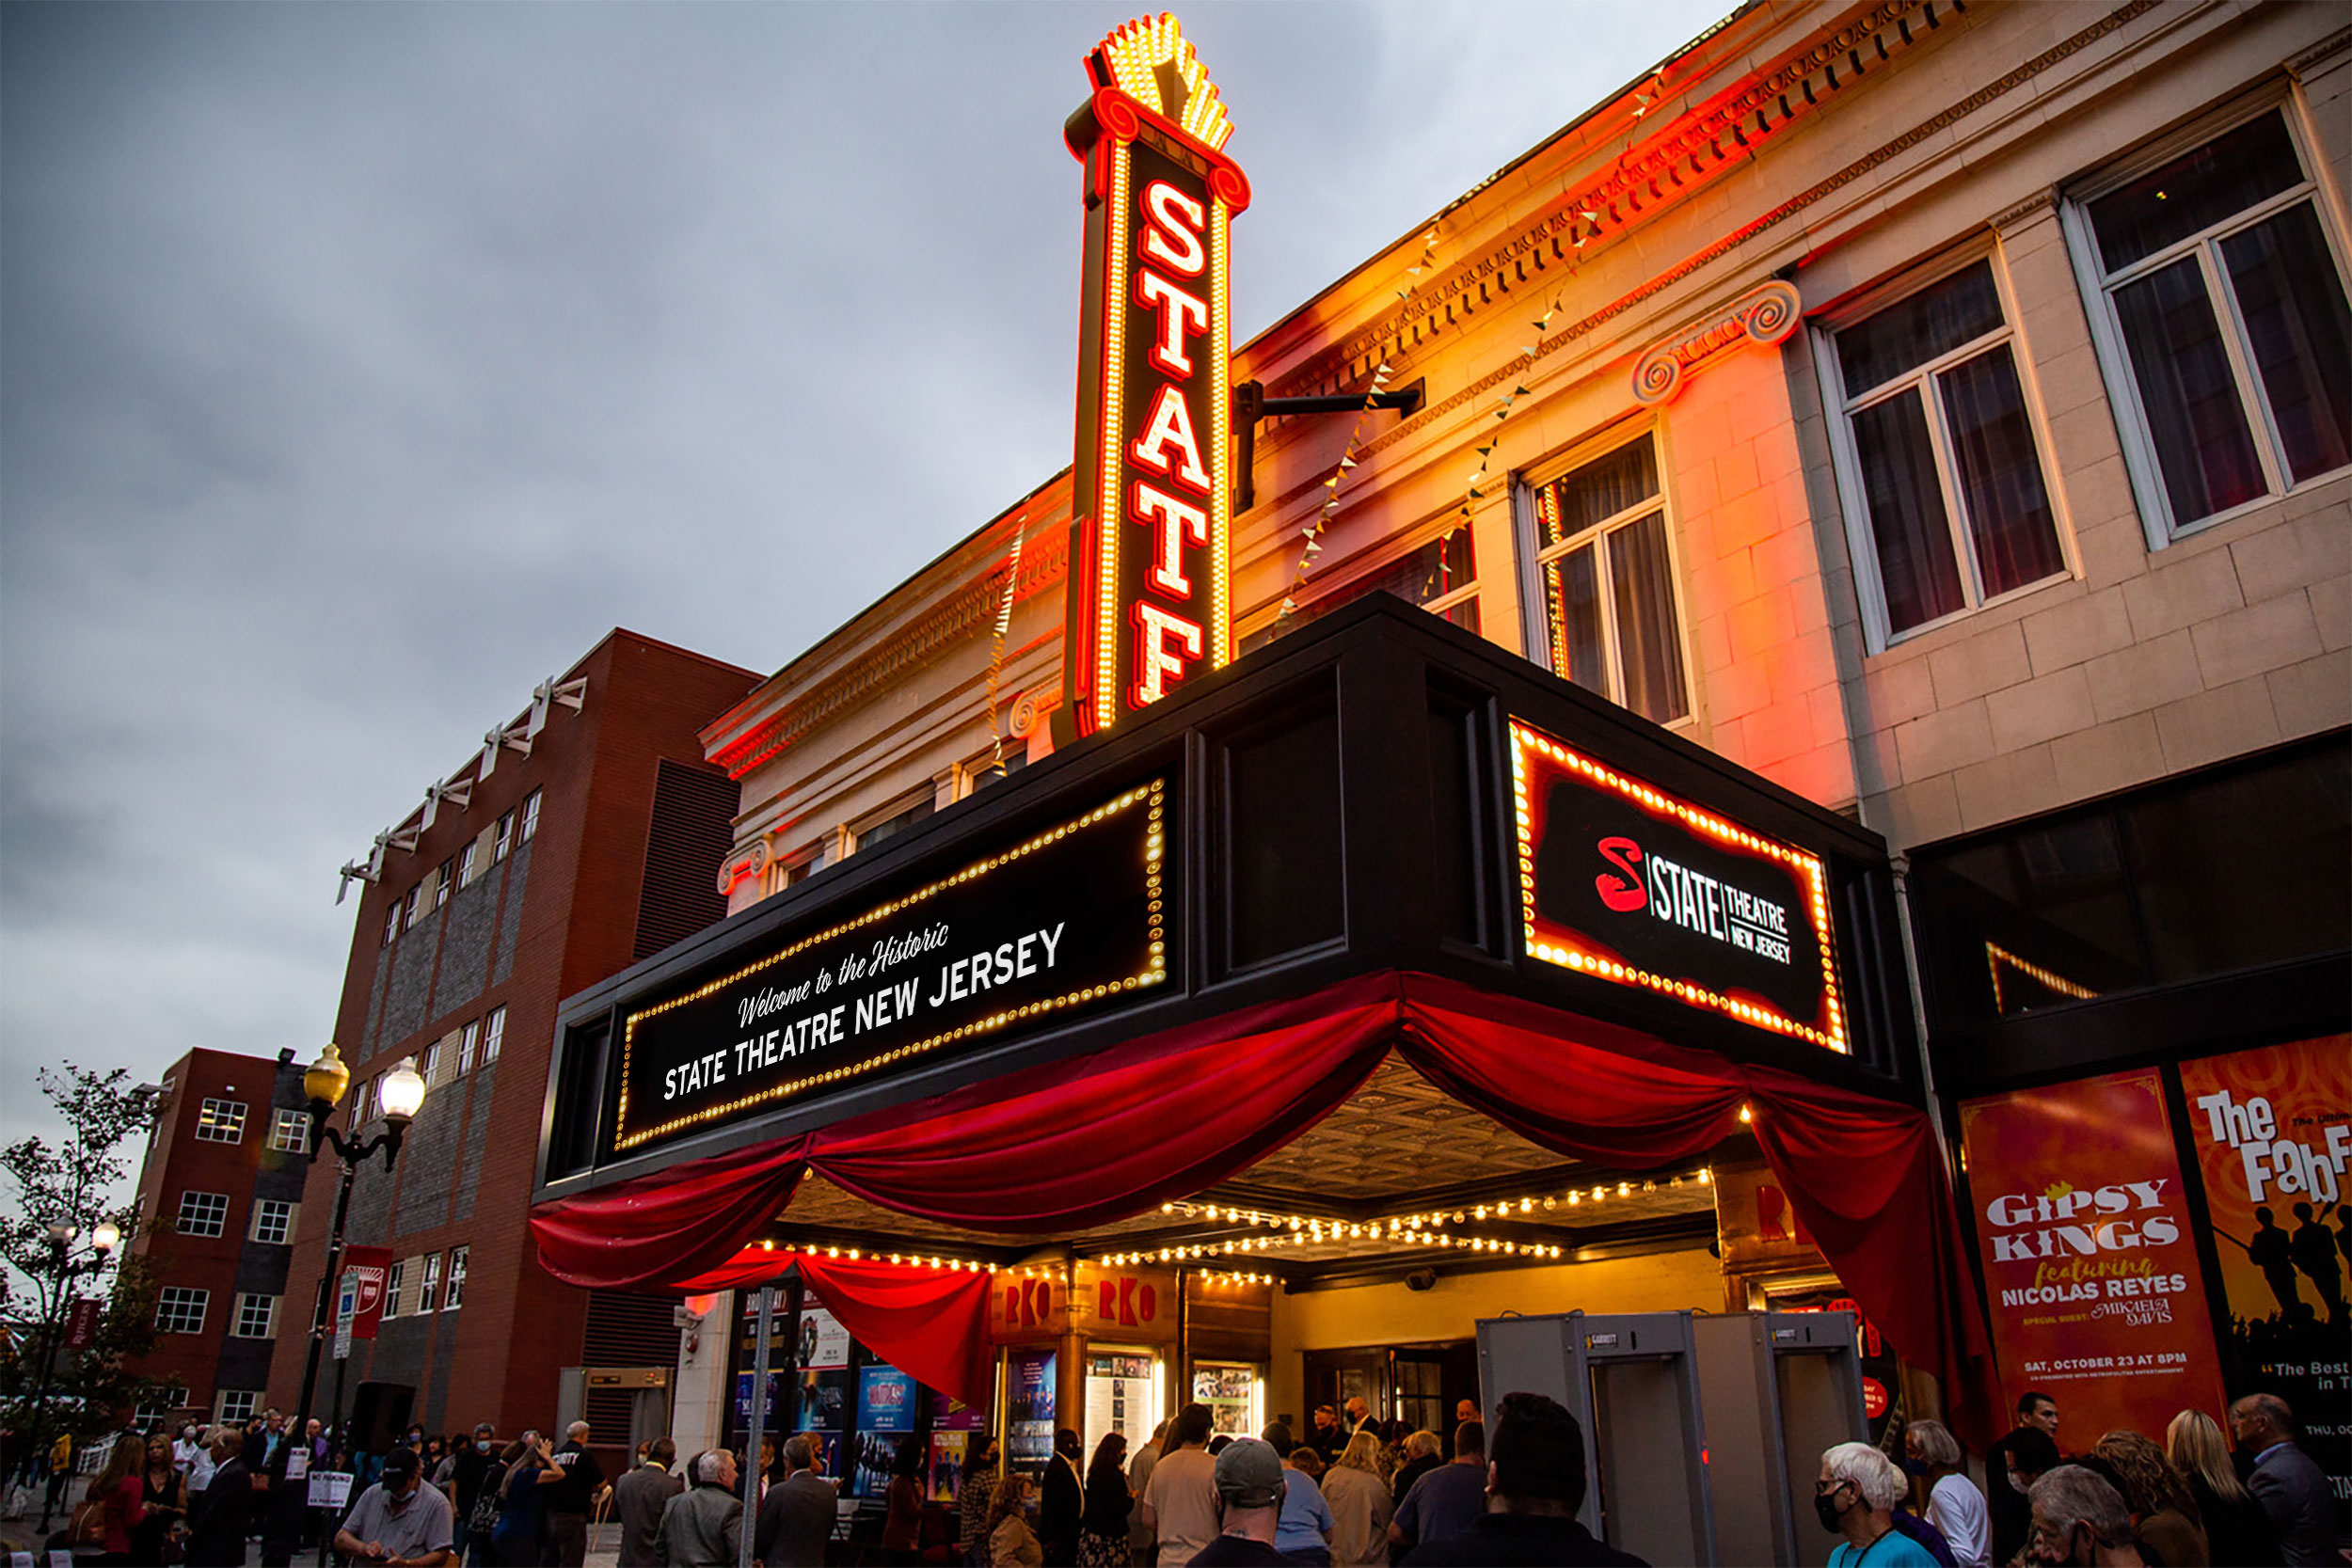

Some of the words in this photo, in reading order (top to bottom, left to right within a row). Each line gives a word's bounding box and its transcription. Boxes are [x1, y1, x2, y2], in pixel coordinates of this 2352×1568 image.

[1651, 855, 1724, 941] STATE
[1724, 884, 1788, 935] THEATRE
[1731, 924, 1754, 952] NEW
[1755, 934, 1790, 964] JERSEY
[738, 987, 810, 1029] Welcome
[816, 971, 834, 993] to
[837, 952, 866, 984] the
[867, 921, 949, 976] Historic
[663, 1049, 726, 1101] STATE
[735, 1005, 846, 1076] THEATRE
[854, 976, 919, 1034] NEW
[929, 922, 1066, 1008] JERSEY
[2197, 1089, 2277, 1148] The
[2317, 1111, 2352, 1125] Ultim
[2001, 1281, 2099, 1307] NICOLAS
[2106, 1274, 2186, 1298] REYES
[2034, 1257, 2158, 1291] featuring
[1006, 1278, 1050, 1327] RKO
[1099, 1277, 1156, 1326] RKO
[2090, 1297, 2169, 1319] MIKAELA
[2126, 1309, 2172, 1327] DAVIS
[2025, 1360, 2052, 1373] SAT,
[2054, 1356, 2114, 1370] OCTOBER
[2117, 1355, 2134, 1367] 23
[2137, 1354, 2153, 1365] AT
[2157, 1352, 2187, 1365] 8PM
[2311, 1361, 2350, 1375] Best
[2318, 1376, 2334, 1390] in
